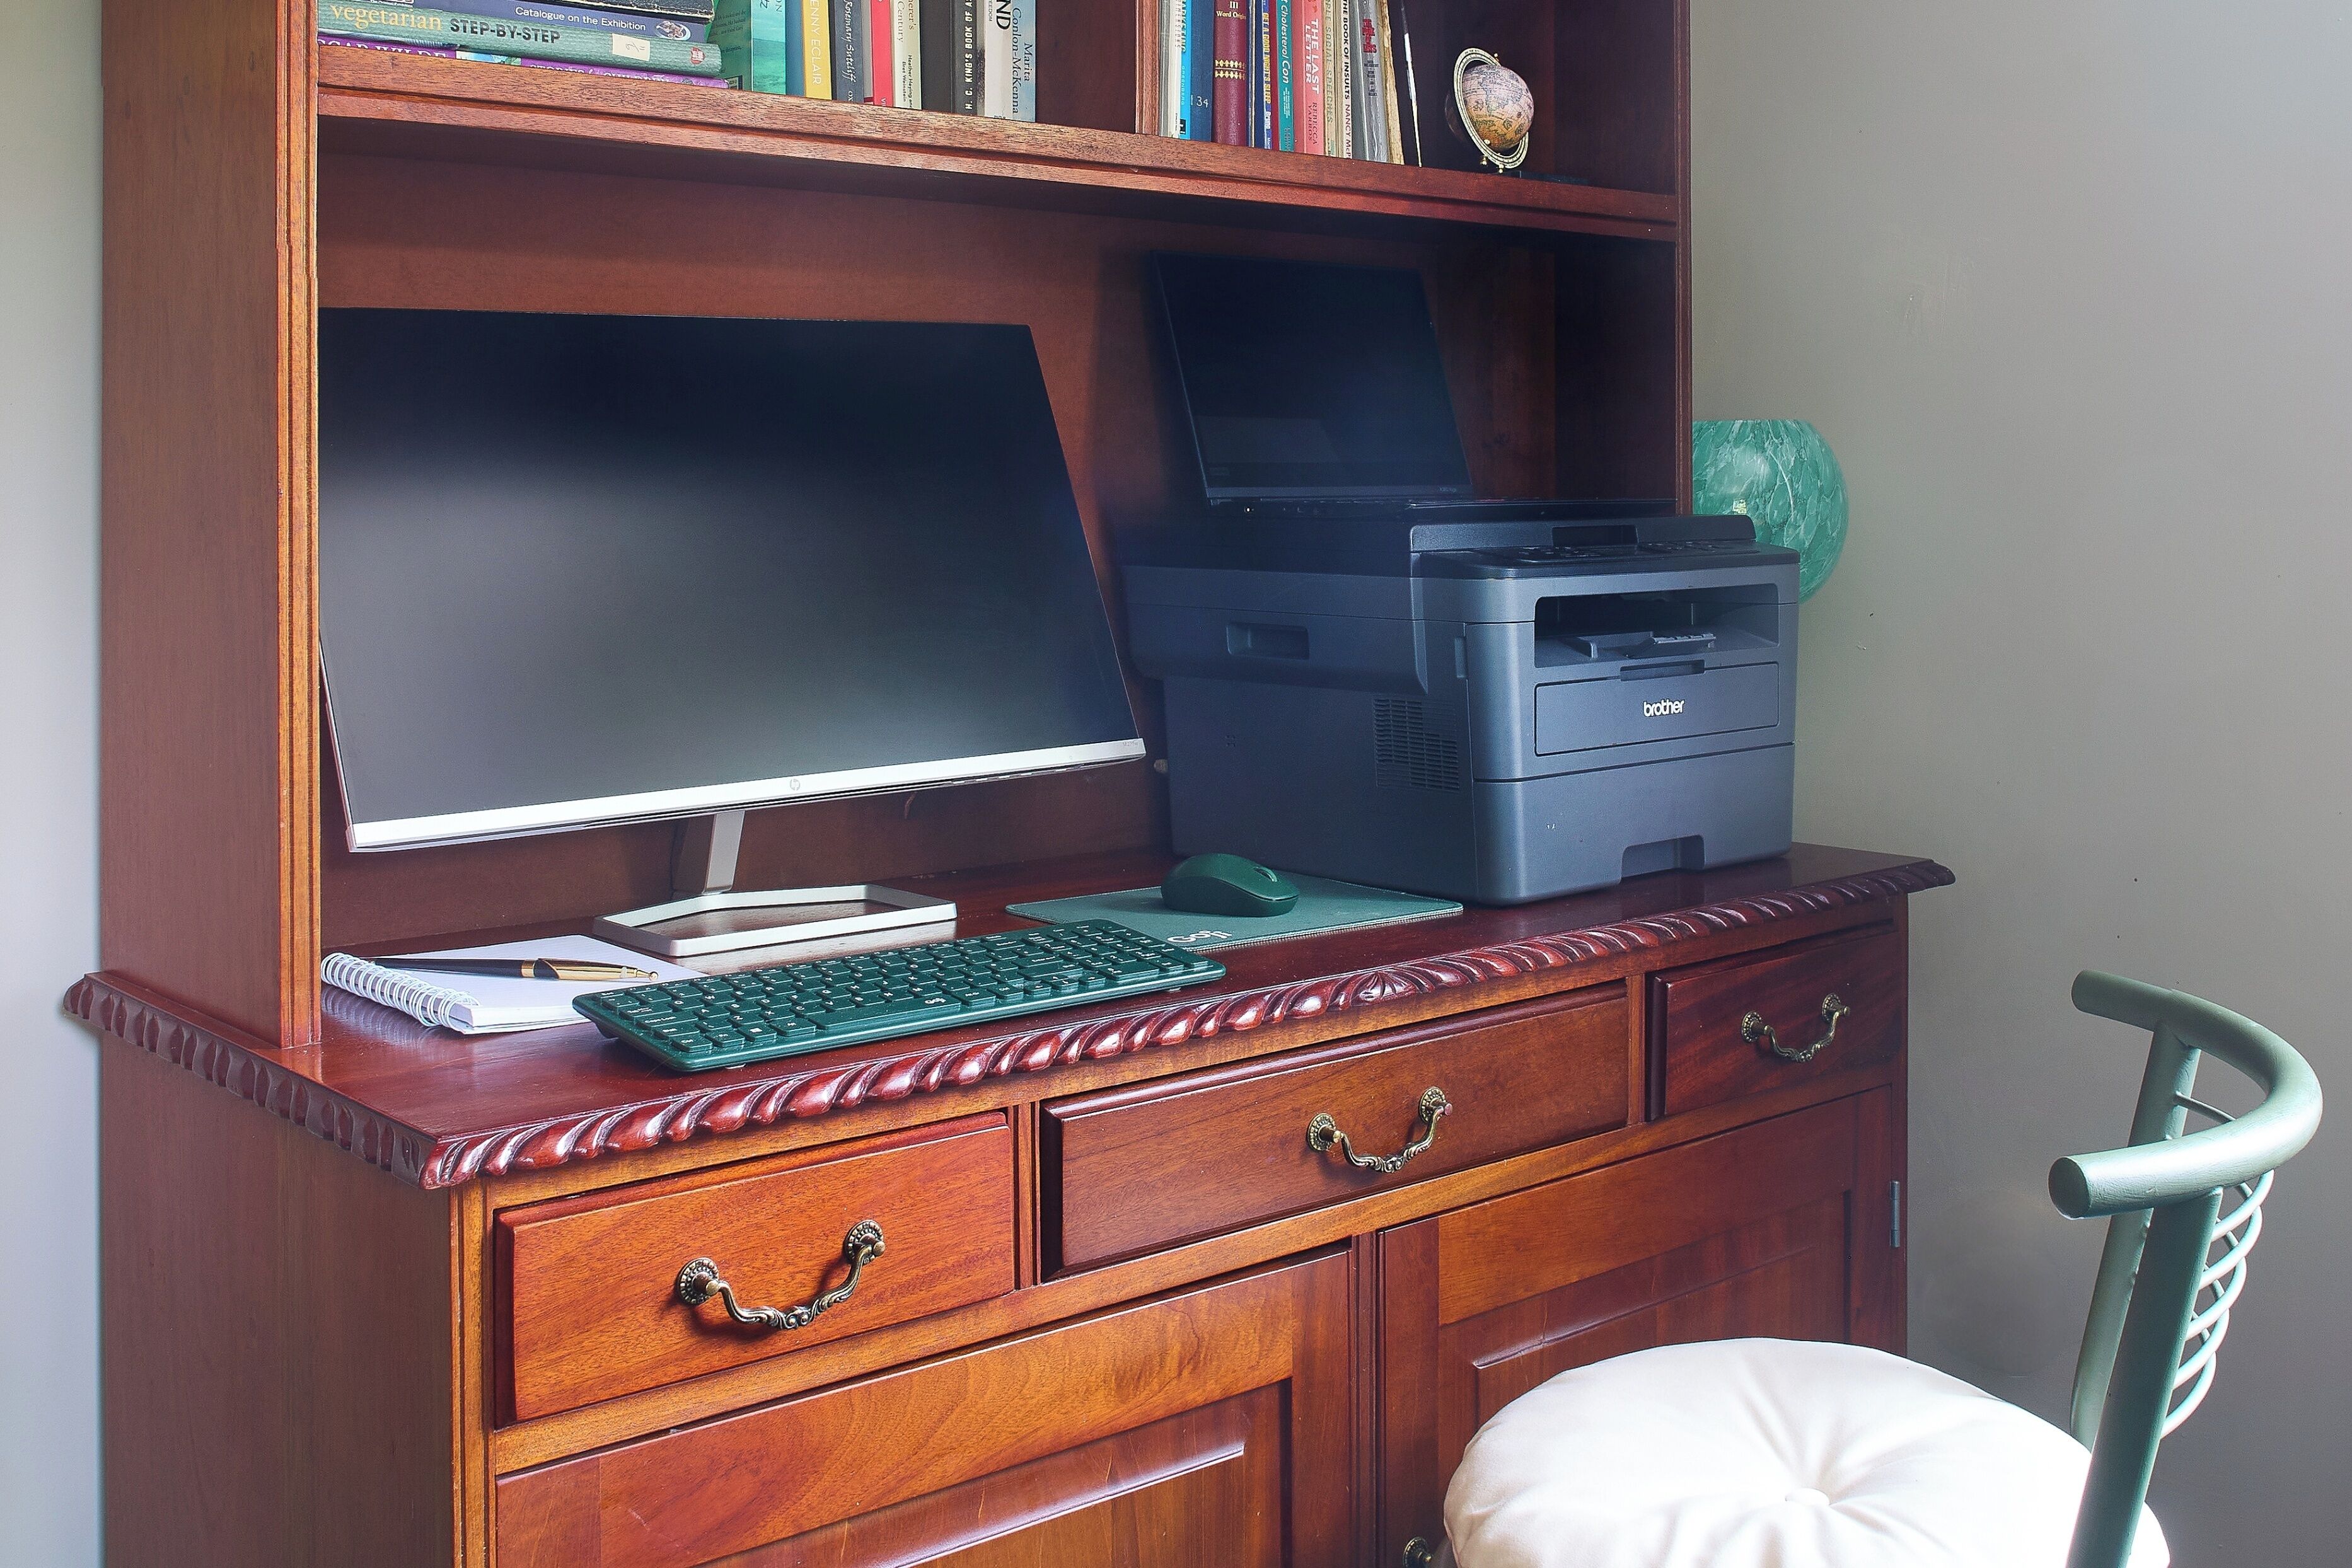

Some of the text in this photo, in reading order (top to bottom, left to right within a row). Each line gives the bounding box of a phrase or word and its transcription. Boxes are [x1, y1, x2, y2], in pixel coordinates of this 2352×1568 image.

[330, 4, 443, 31] vegetarian
[450, 18, 560, 43] STEP-BY-STEP
[514, 6, 565, 21] Catalogue
[582, 16, 598, 25] the
[601, 18, 646, 31] Exhibition
[897, 1, 905, 42] Century
[965, 11, 973, 22] OF
[1281, 5, 1289, 59] Cholesterol
[841, 0, 856, 83] Rosemary Sutcliff
[1343, 47, 1349, 60] OF
[811, 39, 821, 85] ECLAIR
[1012, 8, 1022, 113] Conlon-McKenna
[1024, 43, 1033, 81] Marita
[1282, 60, 1290, 84] Con
[1311, 54, 1319, 95] LAST
[1643, 699, 1684, 717] brother
